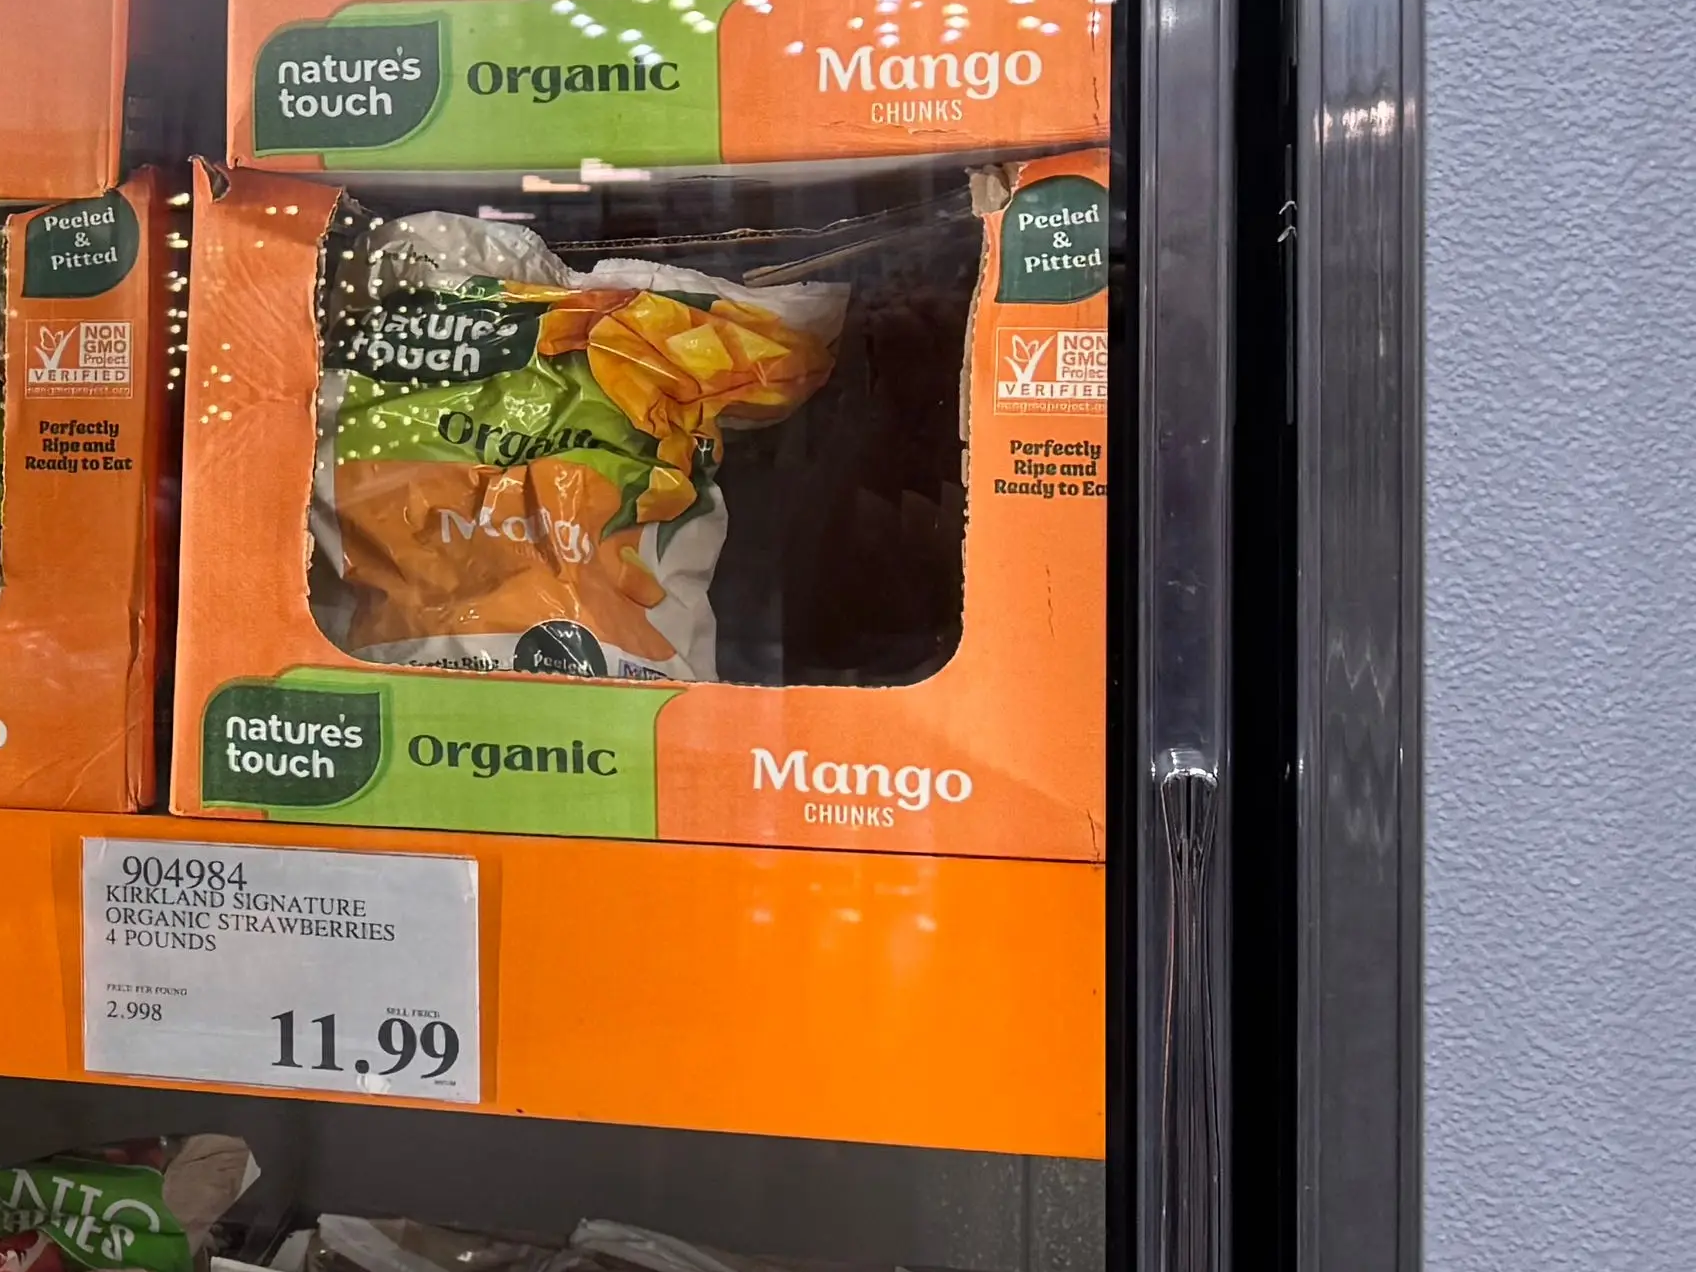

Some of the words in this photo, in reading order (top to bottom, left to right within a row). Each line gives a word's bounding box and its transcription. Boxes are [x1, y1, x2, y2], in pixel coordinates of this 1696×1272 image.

[278, 47, 421, 86] nature's
[467, 56, 680, 100] Organic
[817, 46, 1042, 110] Mango
[280, 86, 392, 119] touch
[871, 100, 963, 125] CHUNKS
[44, 208, 115, 232] Peeled
[74, 232, 90, 247] &
[51, 247, 118, 270] Pitted
[1024, 249, 1102, 273] Pitted
[85, 326, 126, 339] NON
[84, 340, 126, 354] GMO
[34, 370, 126, 381] VERIFIED
[39, 420, 119, 438] Perfectly
[42, 438, 80, 454] Ripe
[83, 439, 115, 452] and
[1010, 440, 1101, 459] Perfectly
[25, 456, 78, 474] Ready
[81, 457, 99, 470] to
[102, 456, 132, 470] Eat
[225, 718, 362, 754] nature's
[227, 747, 336, 780] touch
[408, 735, 617, 779] Organic
[752, 749, 972, 811] Mango
[803, 804, 894, 829] CHUNKS
[123, 856, 247, 891] 904984
[106, 886, 224, 909] KIRKLAND
[233, 894, 366, 916] SIGNATURE
[106, 907, 210, 930] ORGANIC
[218, 914, 395, 942] STRAWBERRIES
[106, 930, 116, 945] 4
[125, 931, 216, 952] POUNDS
[107, 1002, 163, 1022] 2.998
[271, 1010, 459, 1079] 11.99
